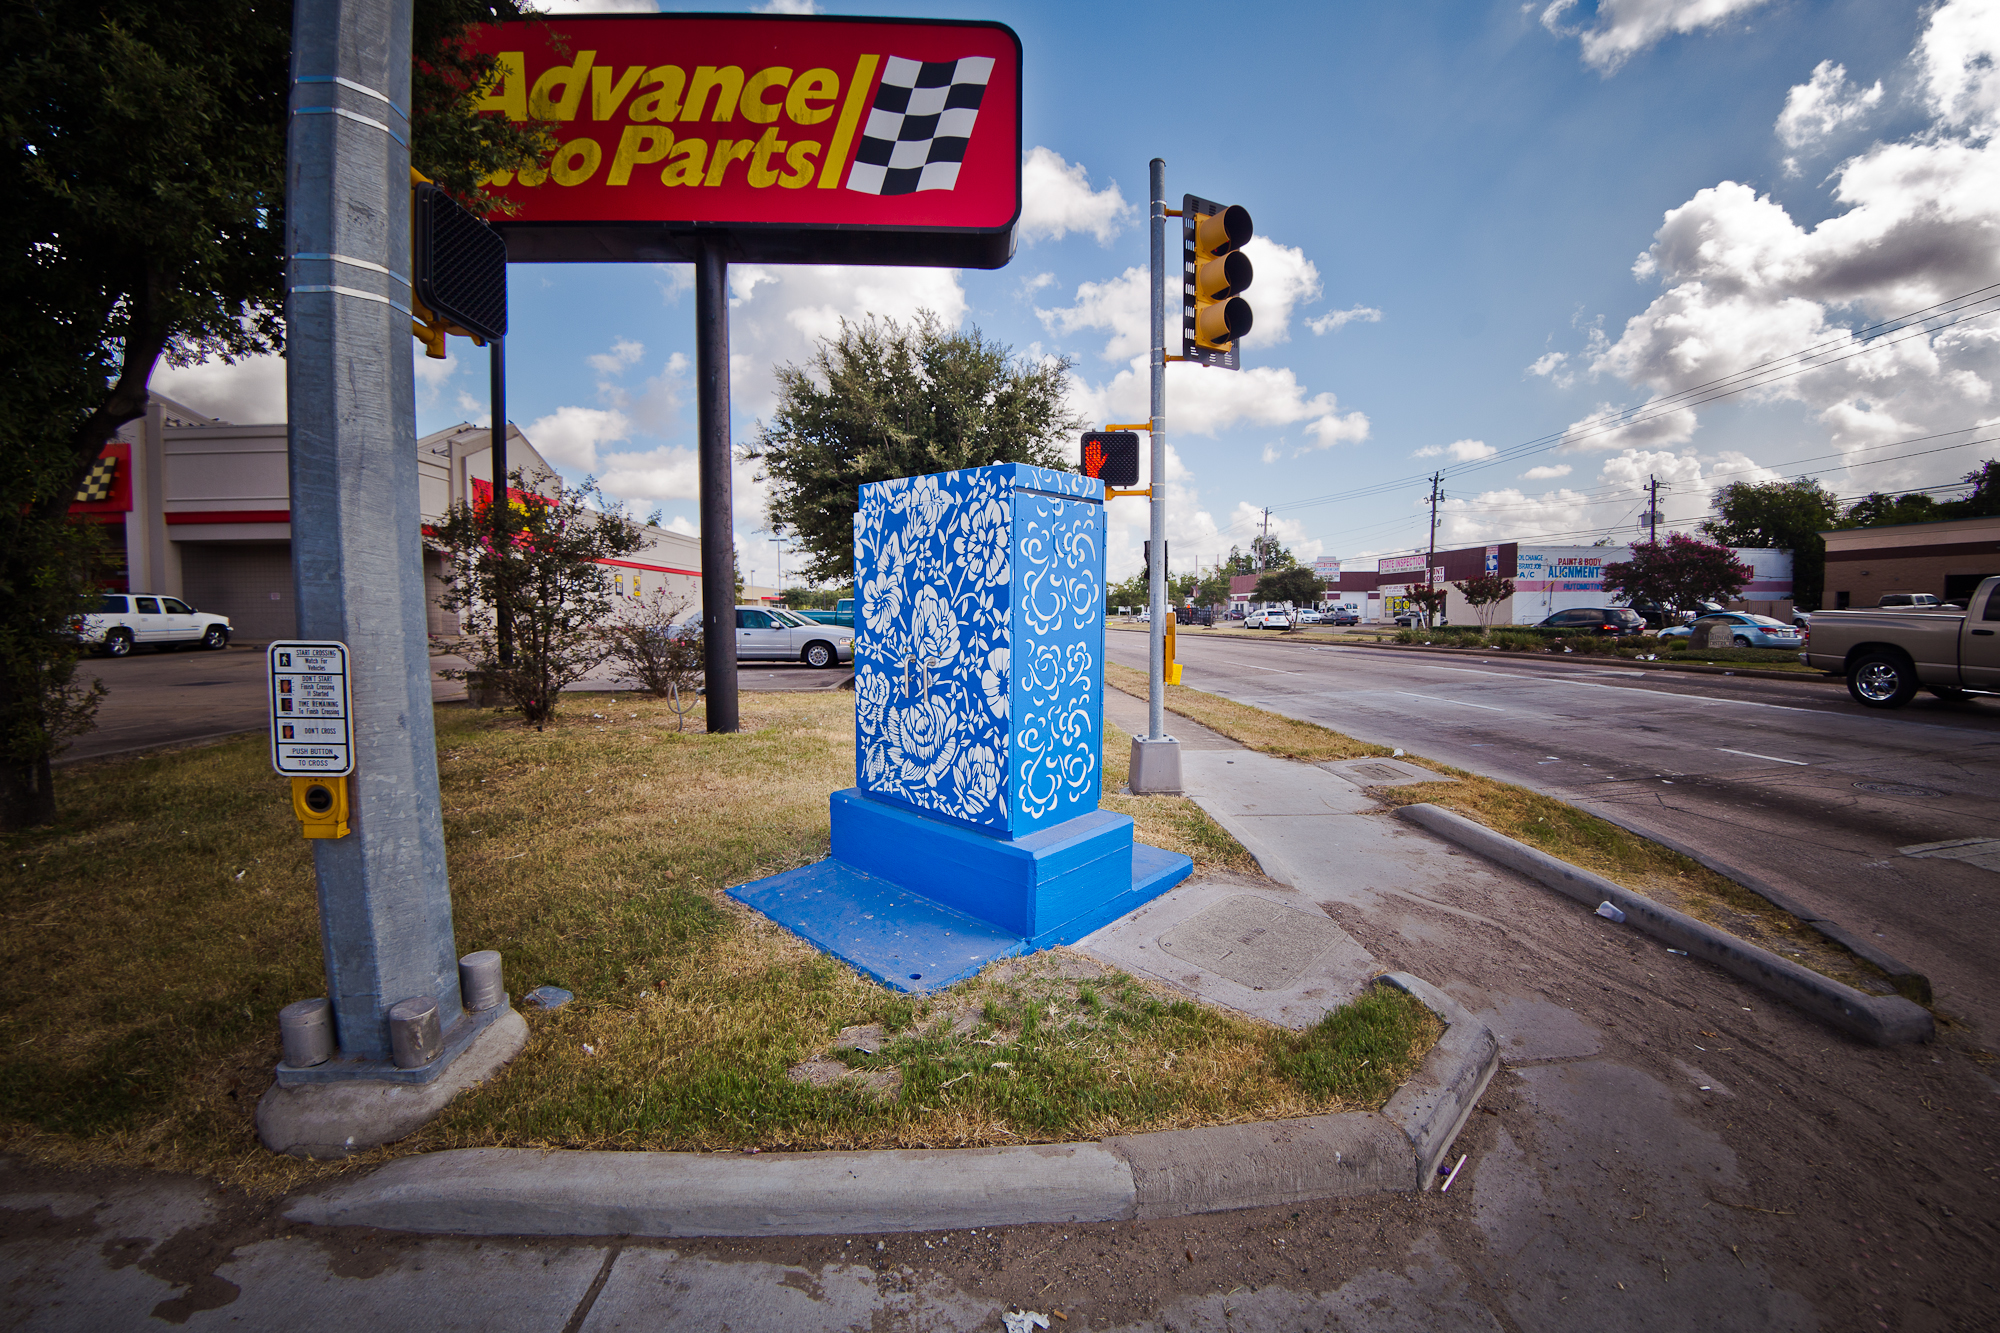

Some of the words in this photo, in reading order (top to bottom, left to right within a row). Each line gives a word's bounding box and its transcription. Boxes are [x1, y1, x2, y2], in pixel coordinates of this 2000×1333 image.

[468, 50, 840, 125] Advance
[470, 127, 602, 187] to
[606, 126, 822, 189] Parts
[1381, 559, 1395, 570] STATE
[1396, 556, 1425, 568] INSPECTION
[1558, 558, 1577, 566] PAINT
[1578, 558, 1583, 566] &
[1585, 558, 1602, 566] BODY
[1426, 568, 1444, 576] PINT
[1548, 566, 1601, 578] ALIGNMENT
[316, 684, 335, 692] Crossing
[312, 700, 339, 708] REMAINING
[298, 707, 304, 715] To
[321, 708, 340, 716] Crossing
[320, 727, 337, 735] CROSS
[298, 759, 307, 767] TO
